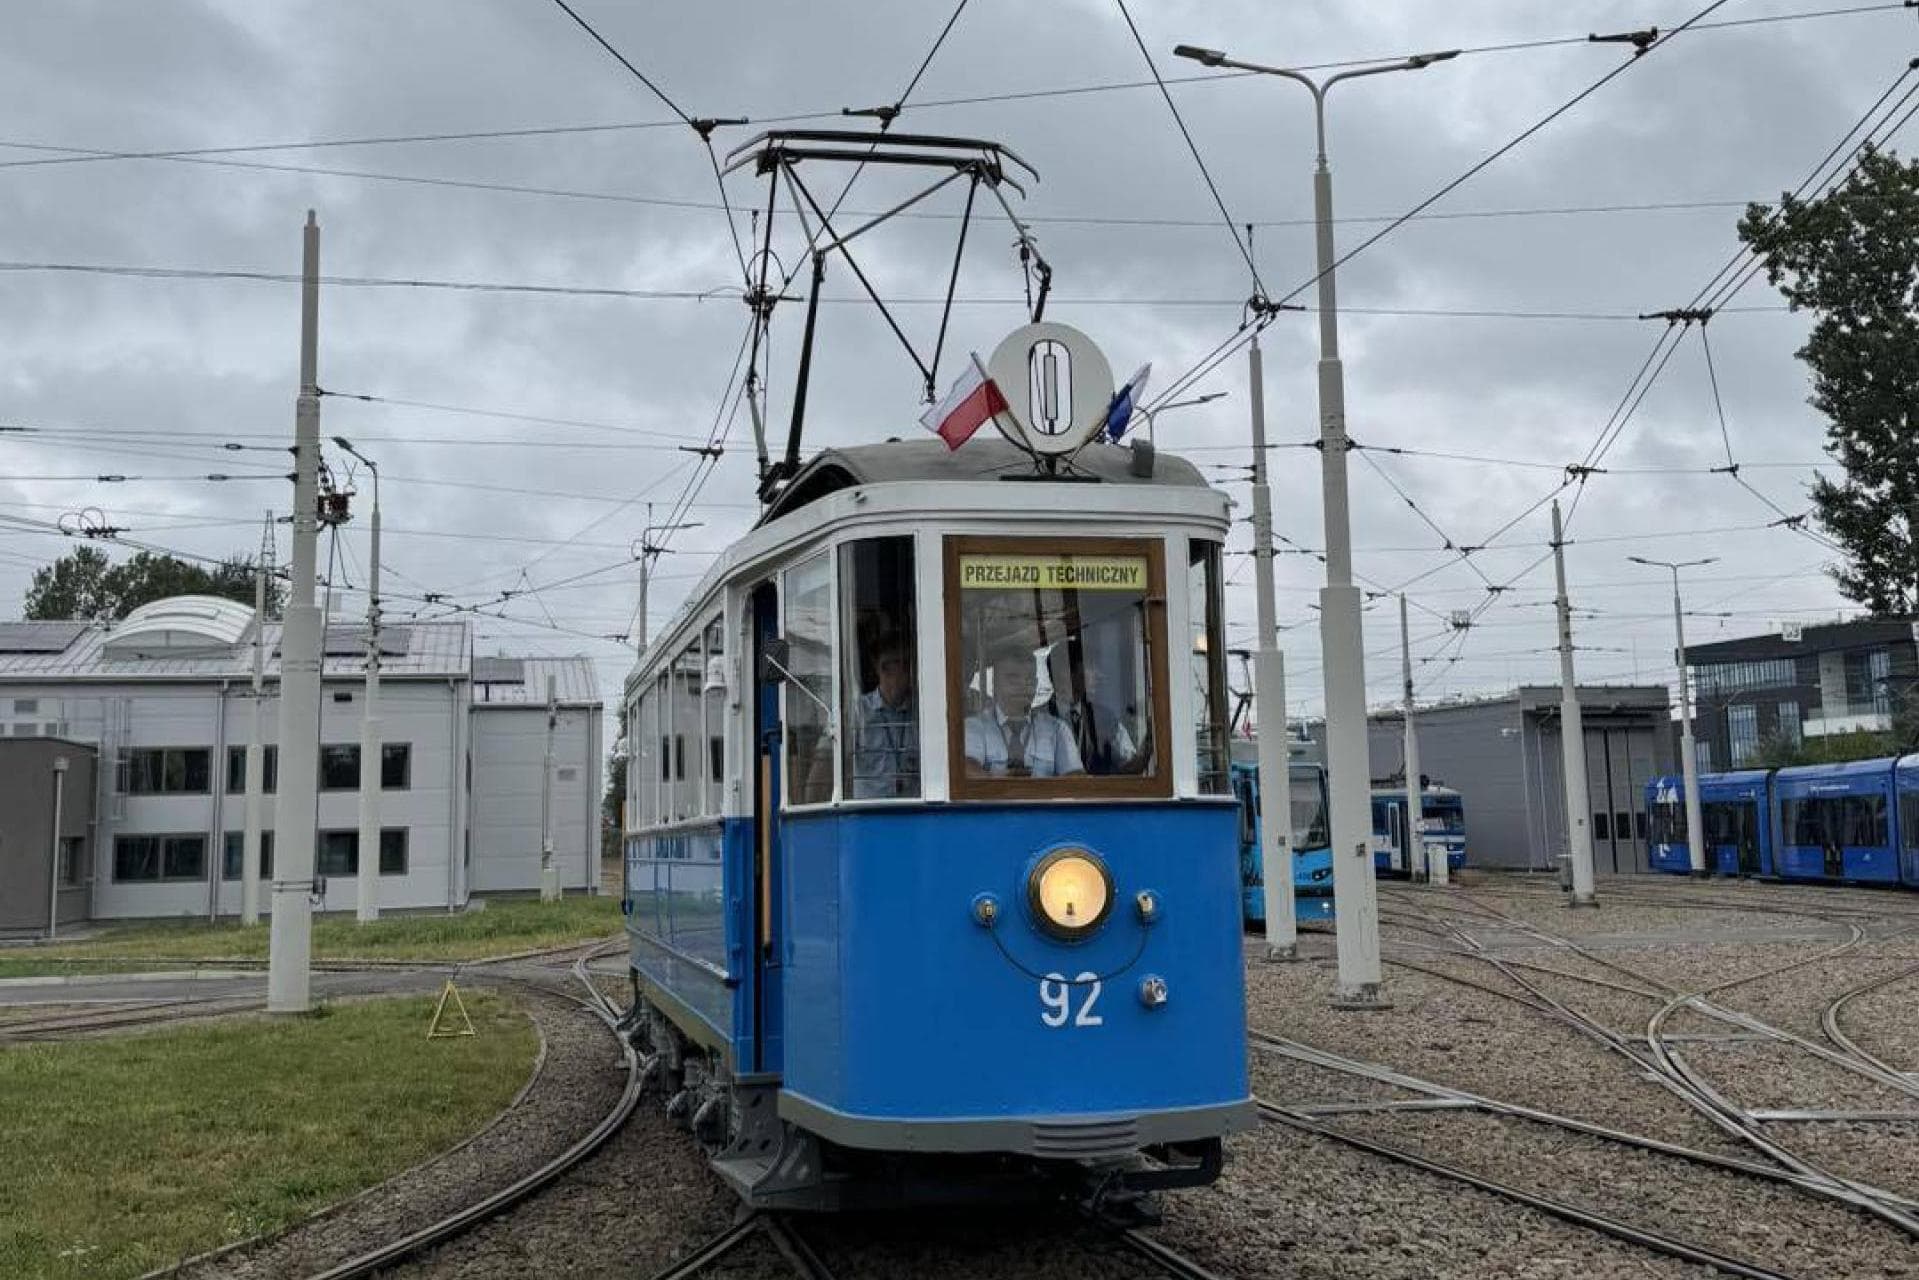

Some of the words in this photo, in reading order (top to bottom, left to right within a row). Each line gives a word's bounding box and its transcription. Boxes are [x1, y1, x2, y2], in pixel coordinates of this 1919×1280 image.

[965, 565, 1041, 582] PRZEJAZD
[1046, 566, 1139, 584] TECHNICZNY
[1039, 970, 1103, 1027] 92
